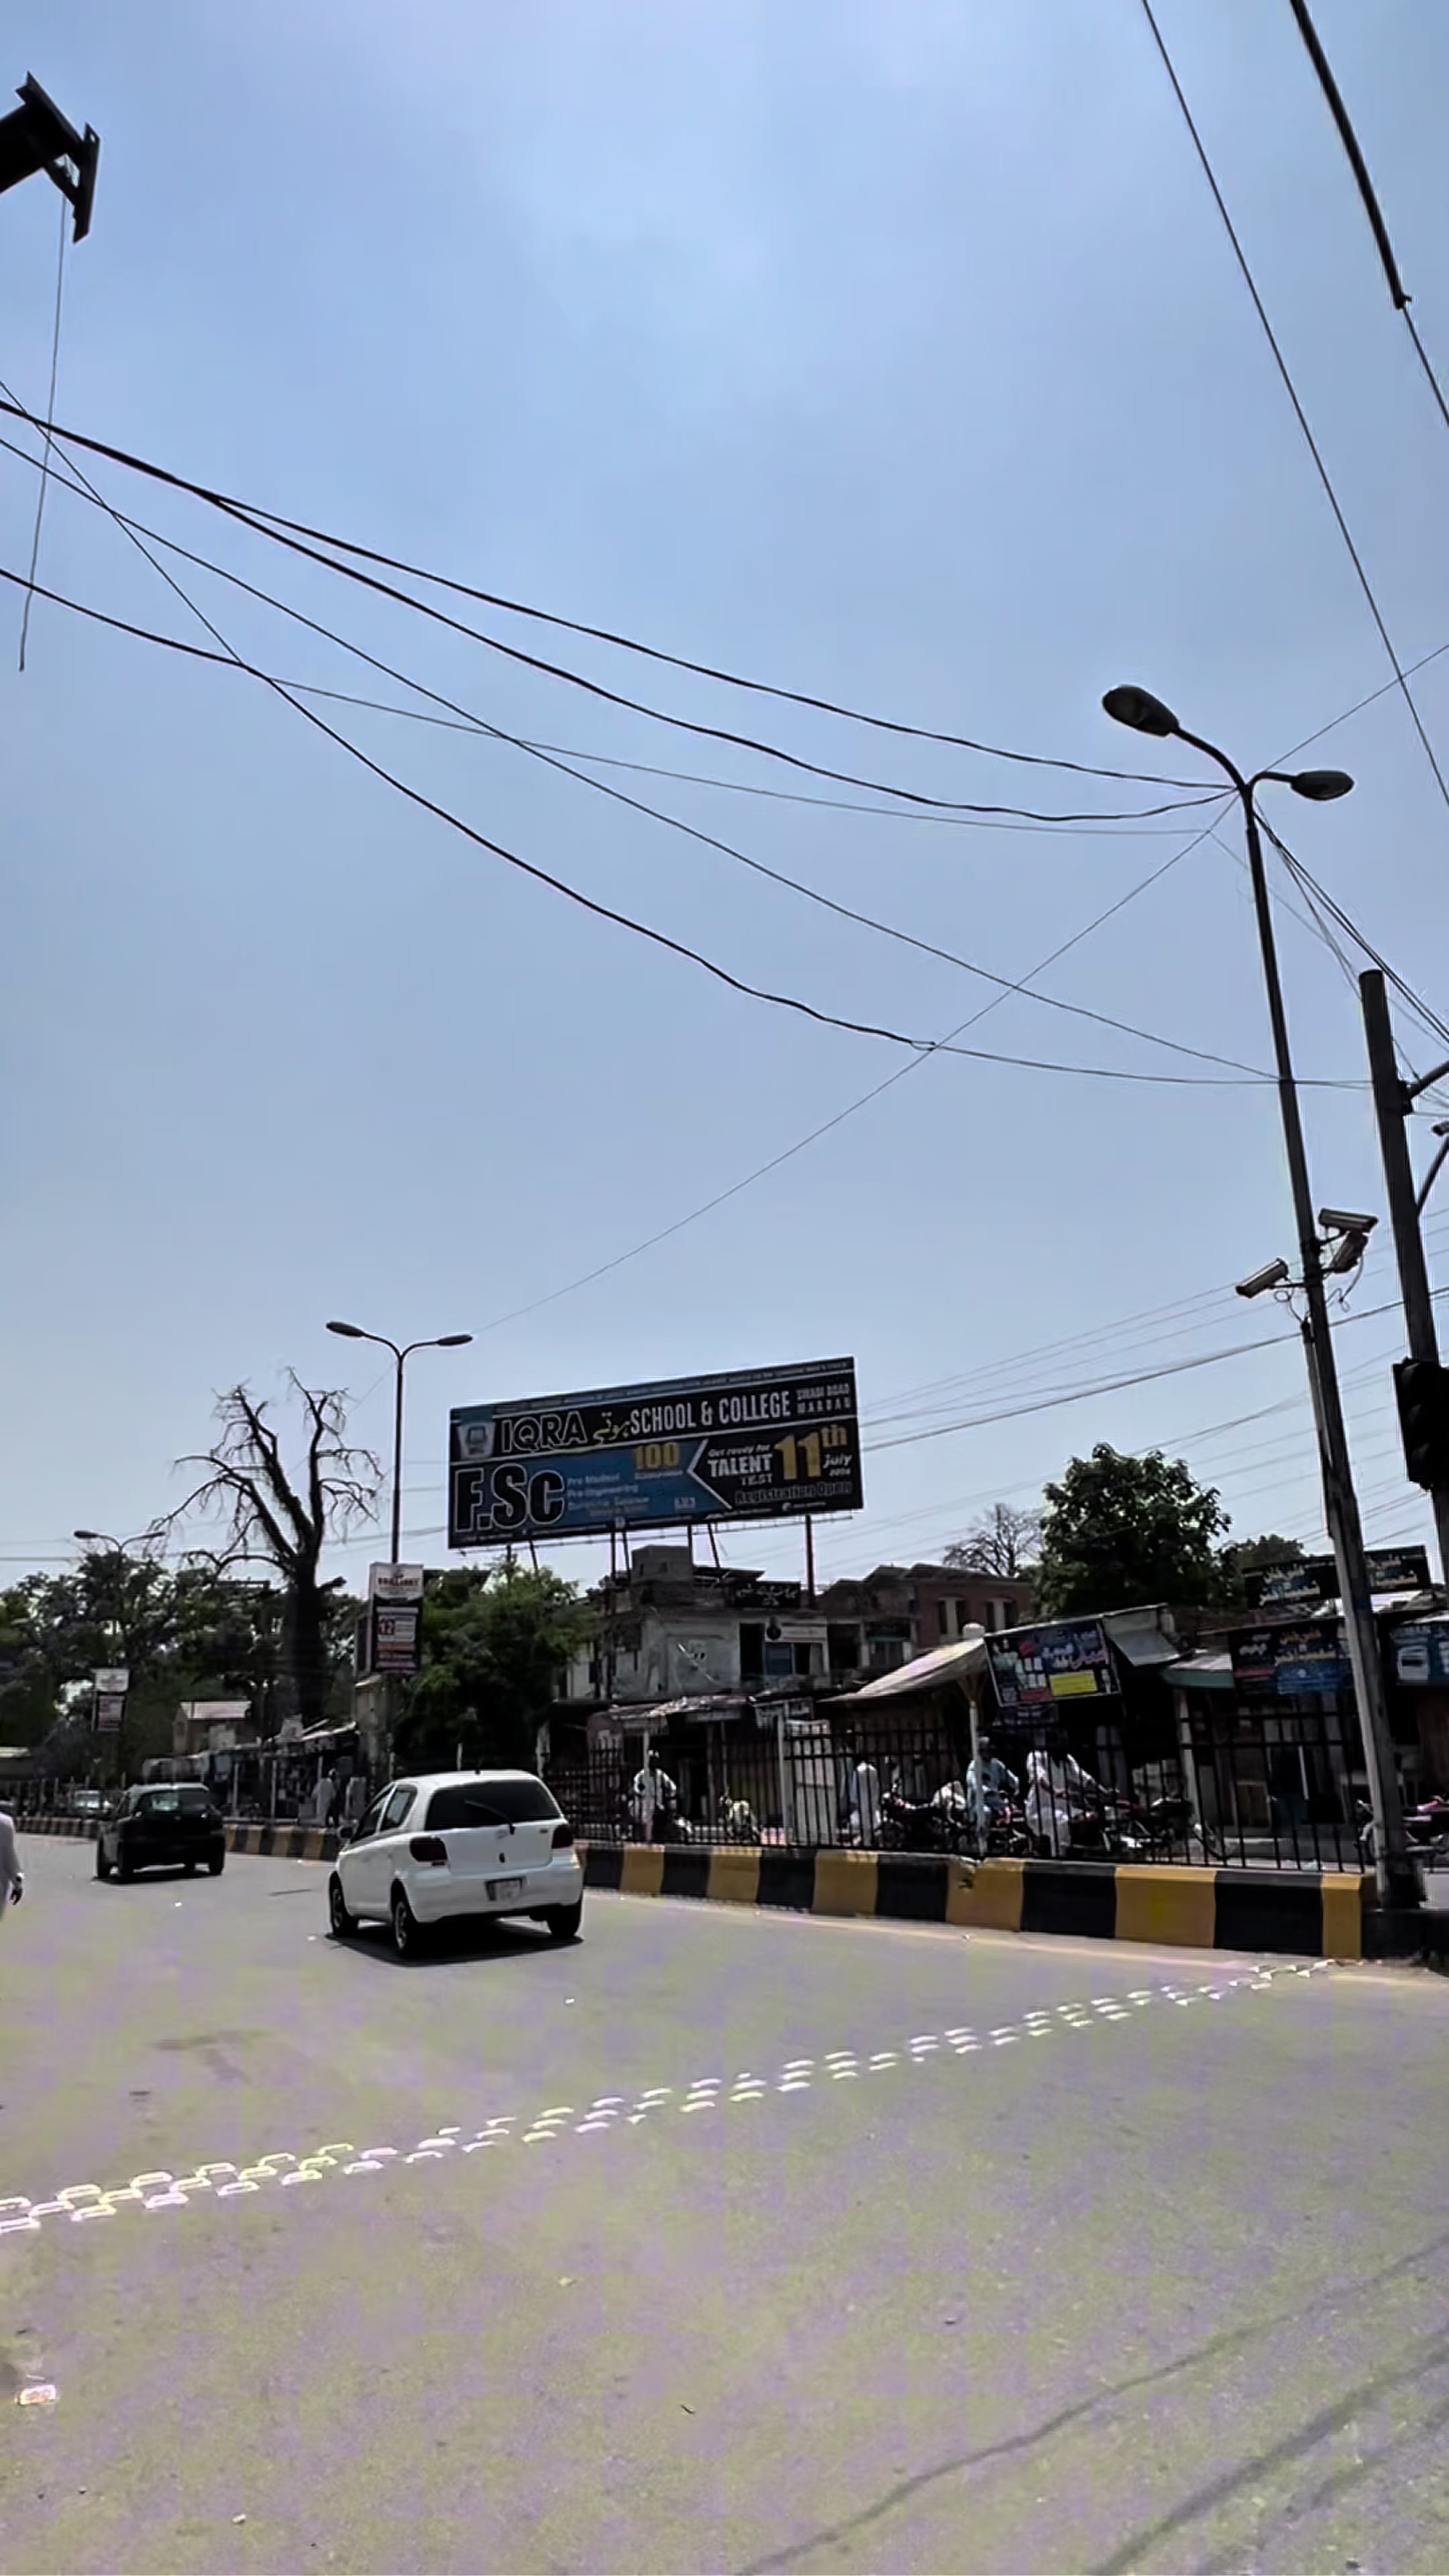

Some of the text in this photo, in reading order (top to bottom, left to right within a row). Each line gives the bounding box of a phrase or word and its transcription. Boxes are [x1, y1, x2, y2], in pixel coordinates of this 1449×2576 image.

[630, 1391, 791, 1435] SCHOOL & COLLEGE
[502, 1411, 588, 1453] IQRA
[635, 1442, 680, 1470] 100
[708, 1454, 773, 1478] TALENT
[741, 1473, 773, 1487] TEST
